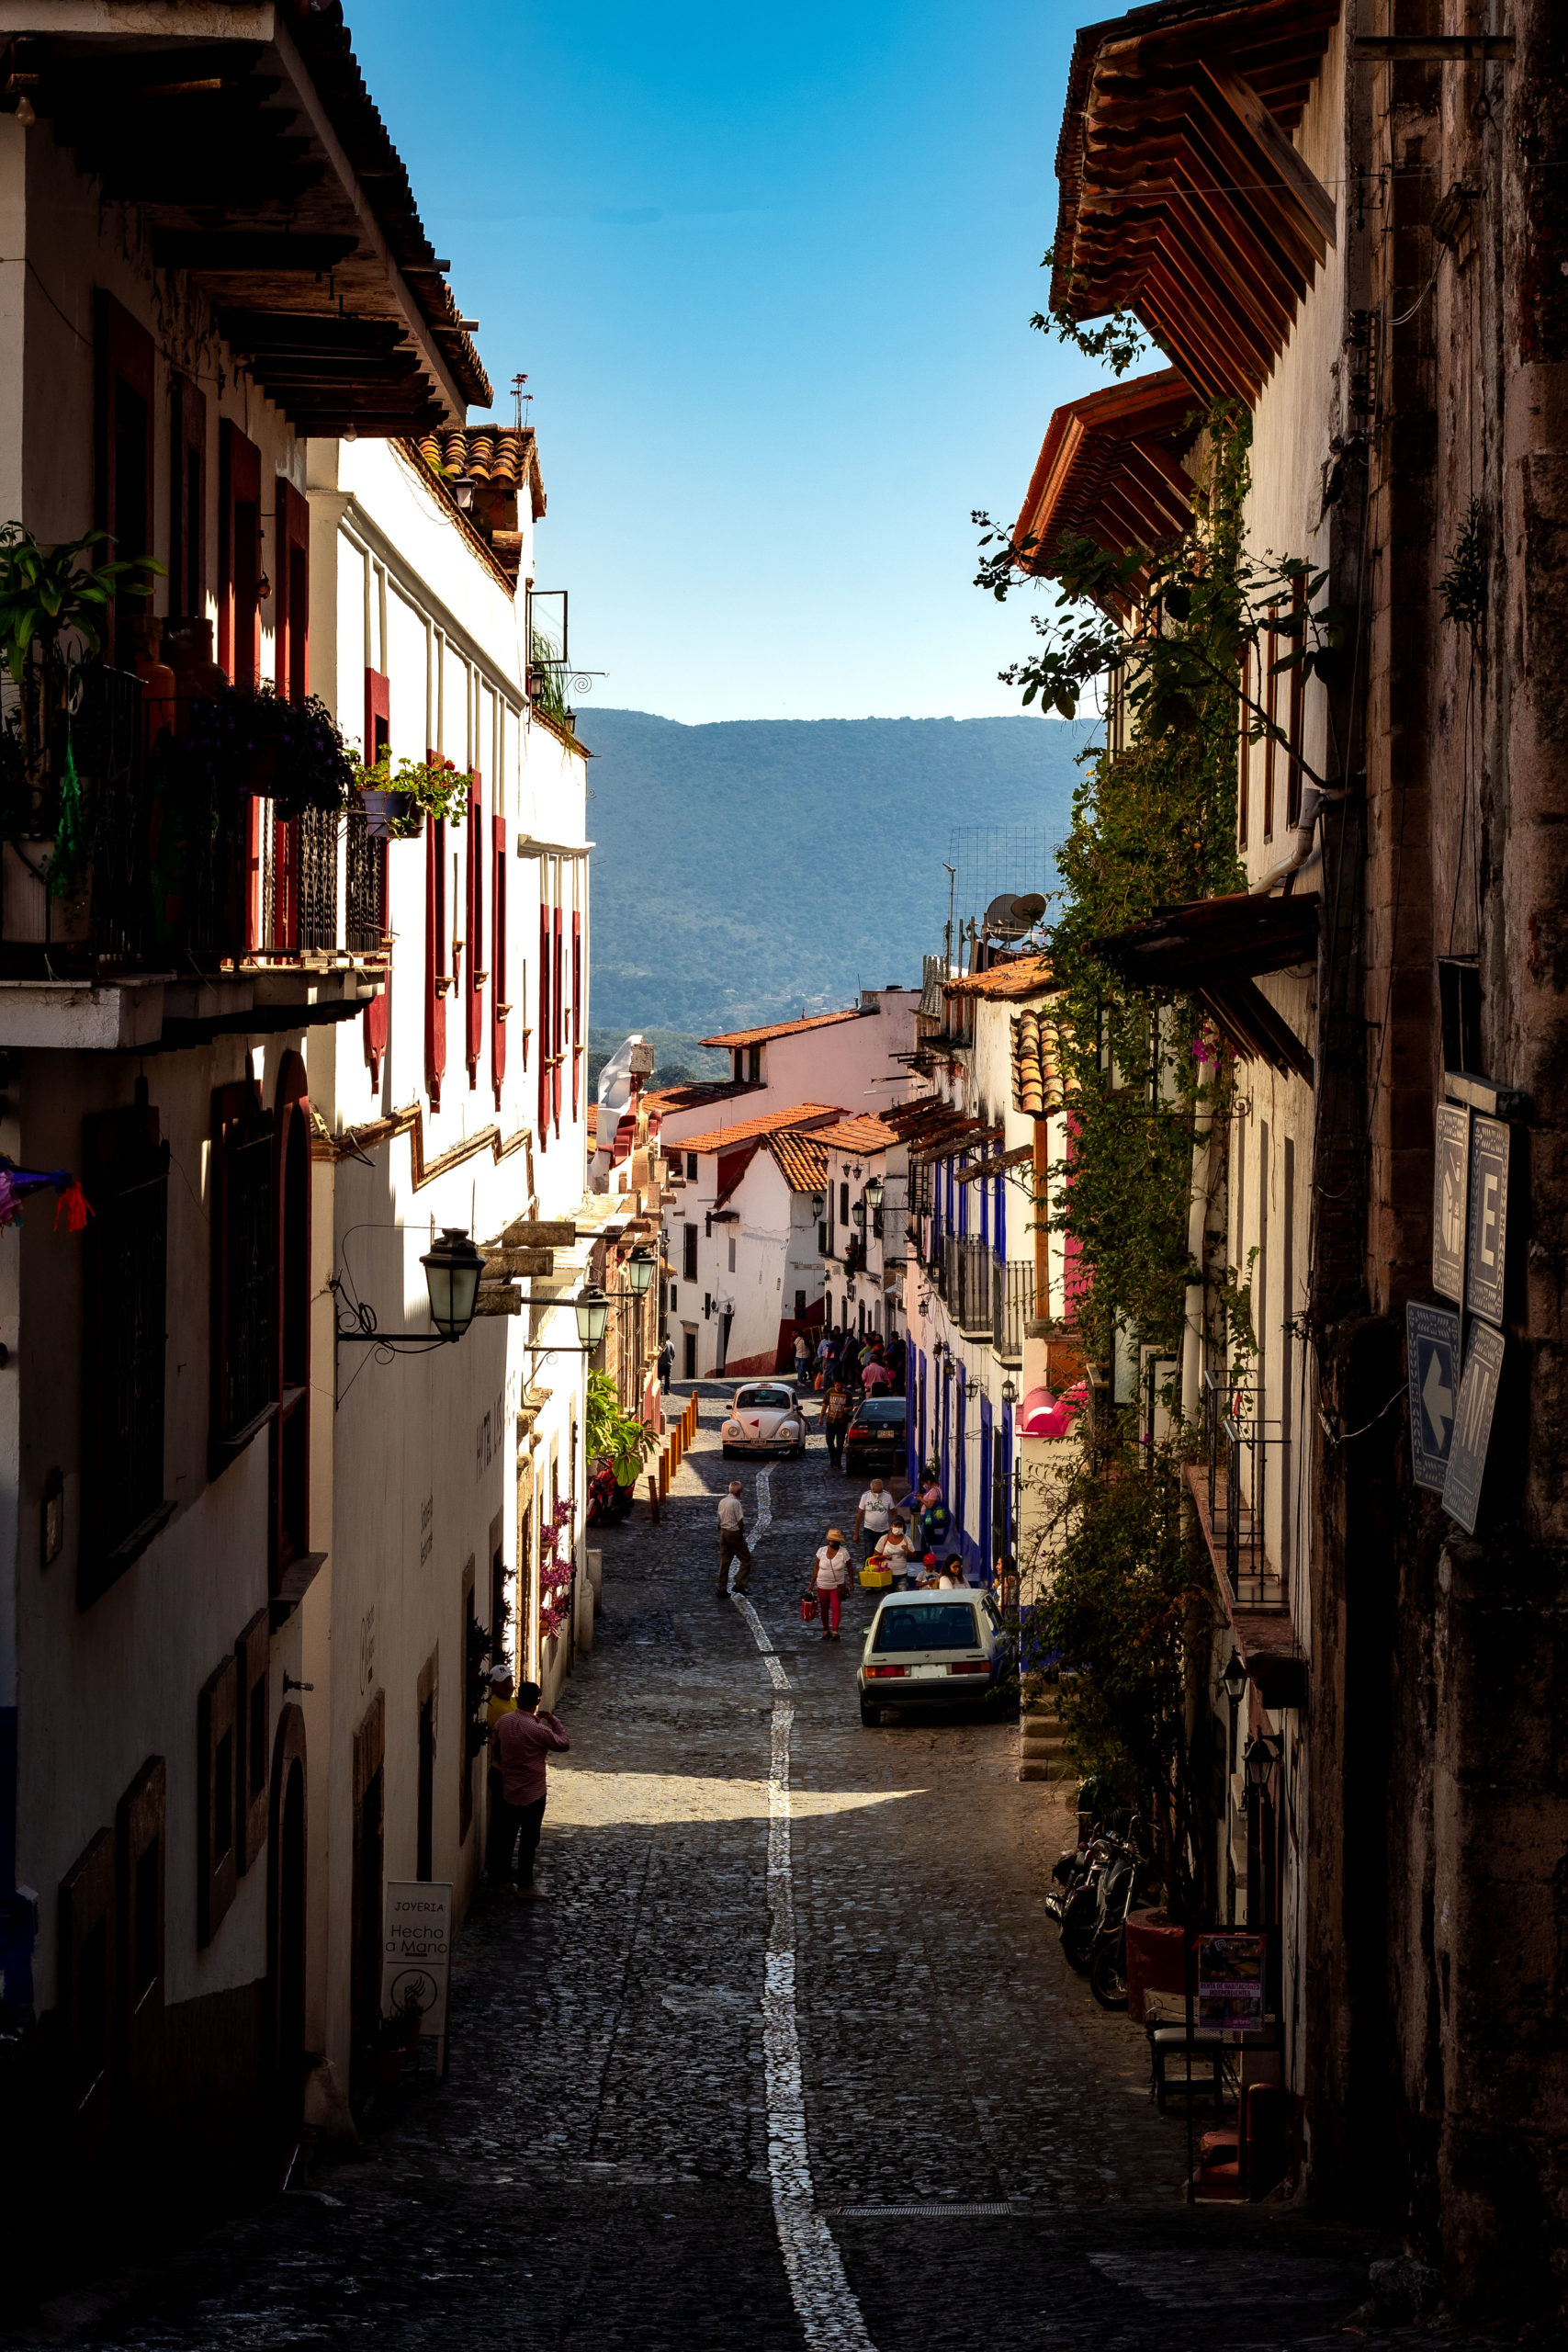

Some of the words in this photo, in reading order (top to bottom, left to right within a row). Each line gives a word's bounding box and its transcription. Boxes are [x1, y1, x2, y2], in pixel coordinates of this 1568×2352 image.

[1480, 1173, 1499, 1267] E
[1461, 1362, 1491, 1458] M
[394, 1902, 444, 1912] JOYERIA
[391, 1925, 444, 1939] Hecho
[385, 1941, 396, 1952] a
[401, 1939, 447, 1953] Mano
